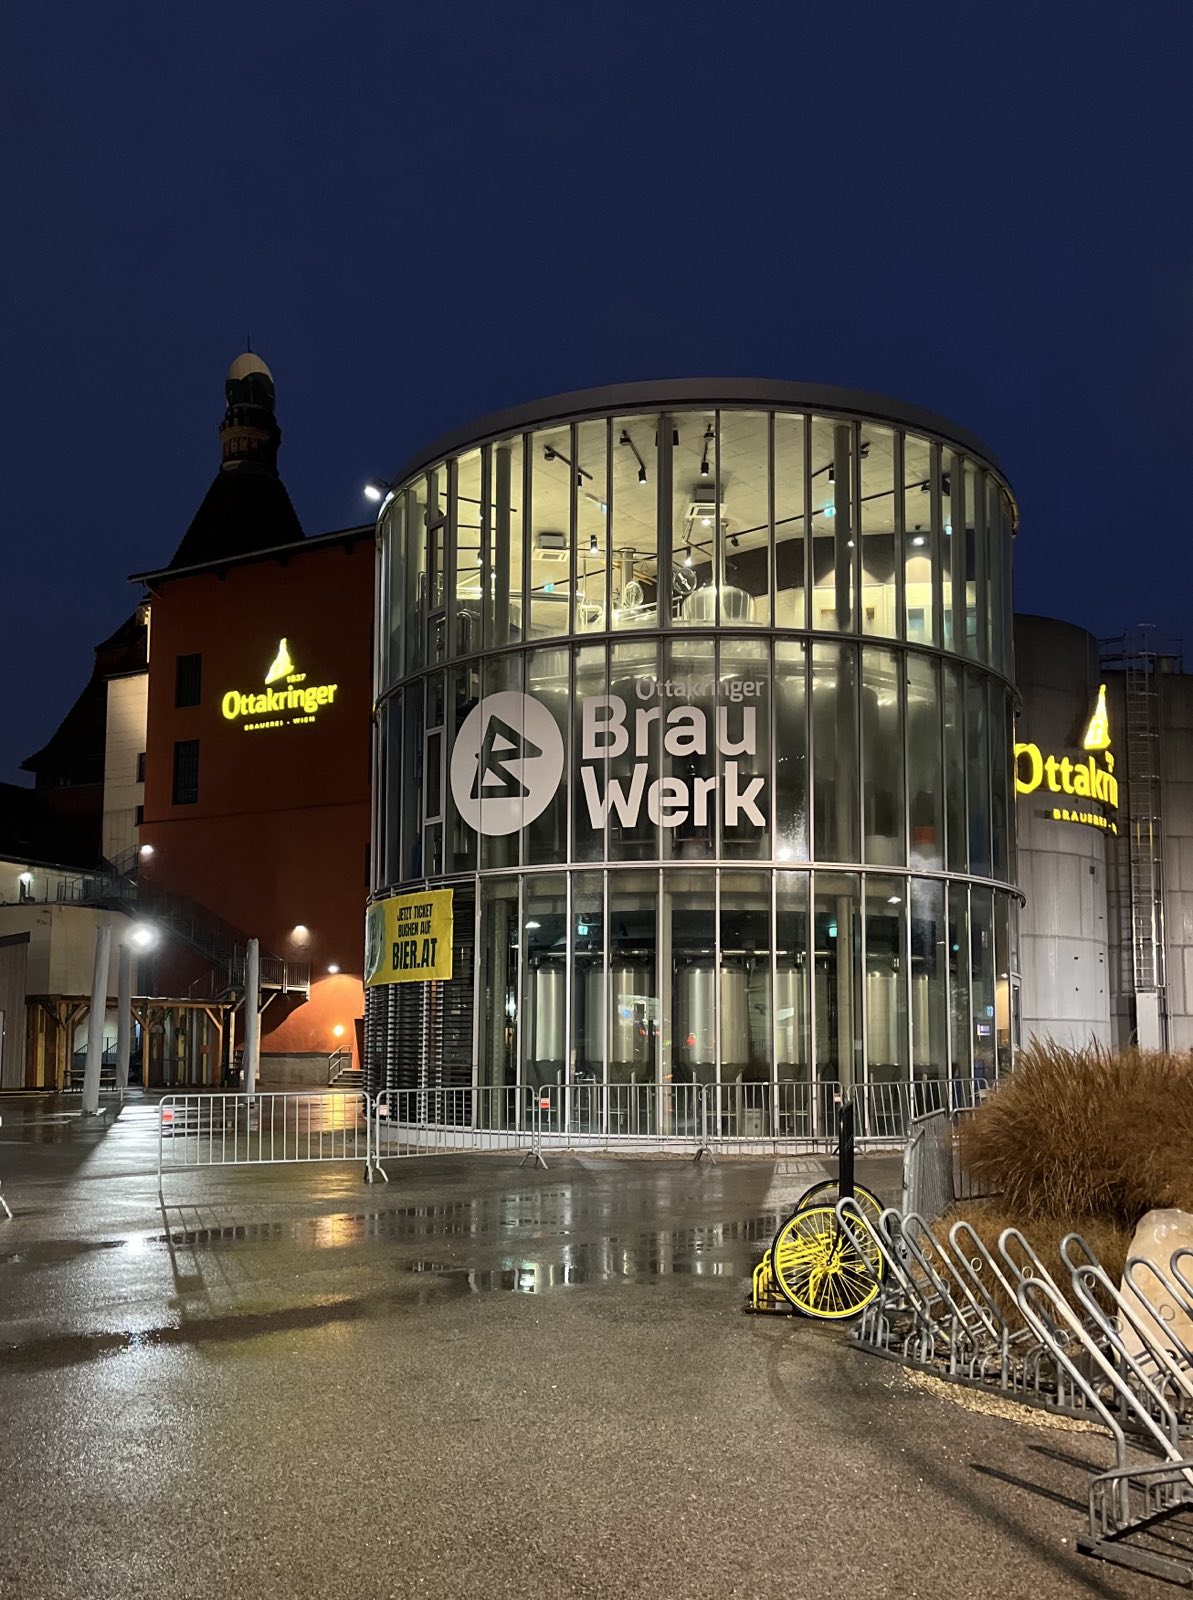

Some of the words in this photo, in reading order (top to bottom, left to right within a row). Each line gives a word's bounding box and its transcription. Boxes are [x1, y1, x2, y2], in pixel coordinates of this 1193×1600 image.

[222, 684, 337, 719] Ottakringer
[635, 674, 765, 702] Ottakringer
[292, 716, 316, 724] WIEN
[582, 694, 756, 760] Brau
[580, 761, 766, 829] Werk
[1053, 808, 1107, 828] BRAUEREI
[397, 906, 412, 921] JETZT
[414, 904, 433, 919] TICKET
[398, 922, 419, 938] BUCHEN
[420, 920, 431, 935] AUF
[393, 938, 437, 970] BIER.AT
